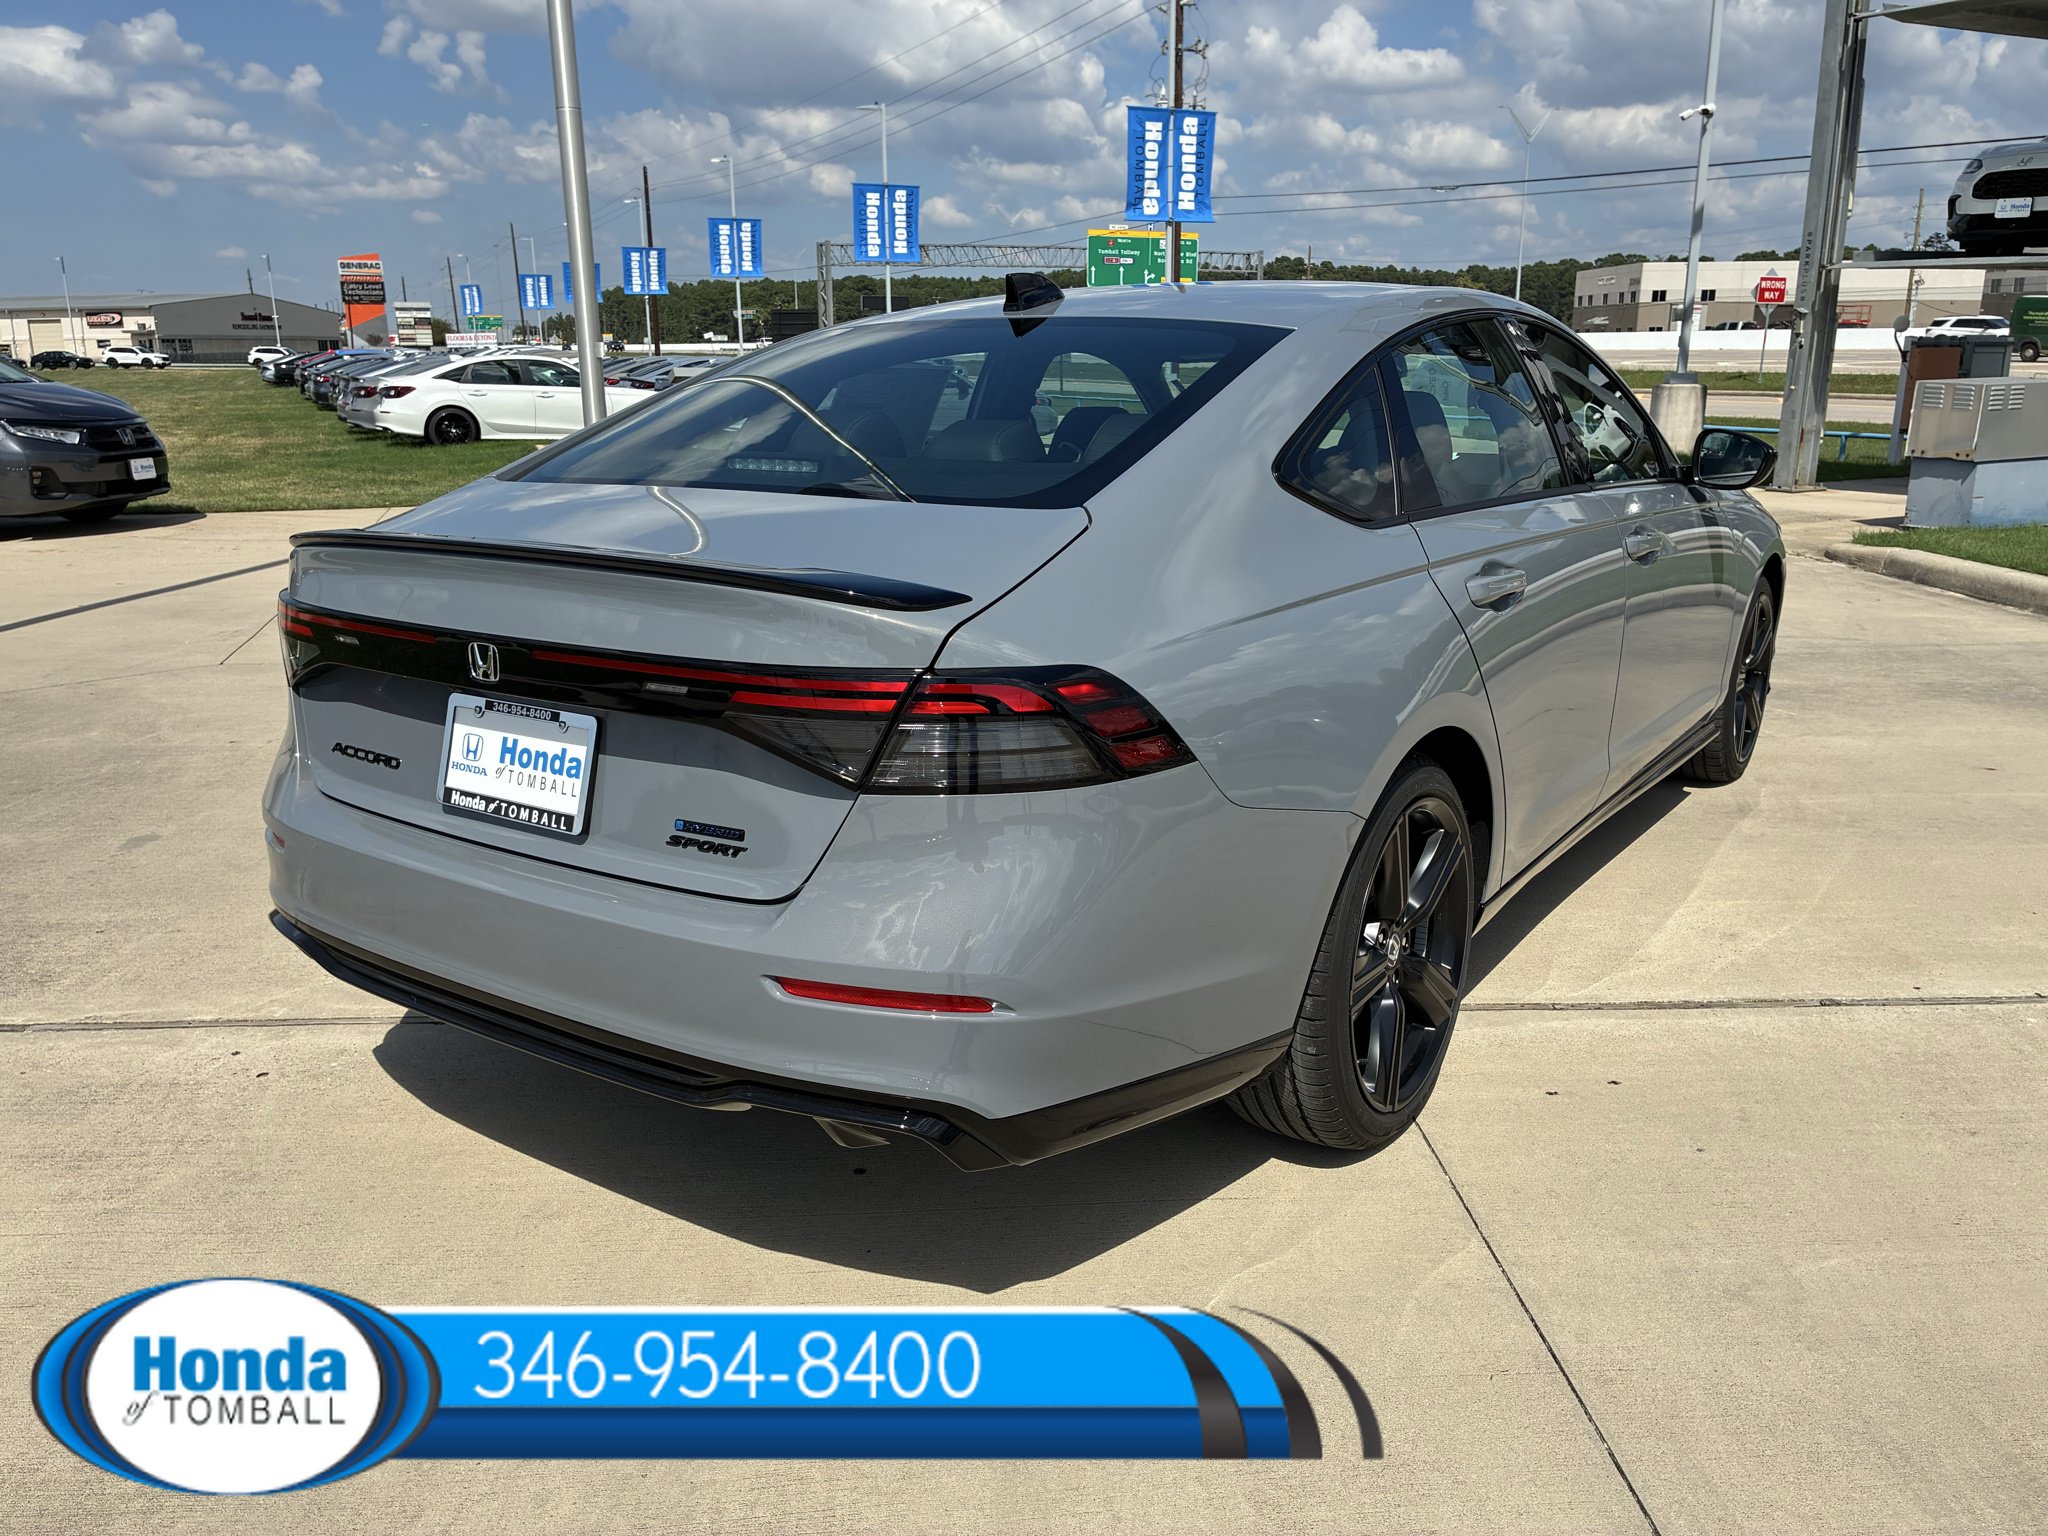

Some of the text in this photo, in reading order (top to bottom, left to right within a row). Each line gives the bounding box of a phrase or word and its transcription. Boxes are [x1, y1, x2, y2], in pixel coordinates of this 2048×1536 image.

[1133, 136, 1144, 214] TOMBALL
[1143, 121, 1163, 215] Honda
[1178, 117, 1198, 210] Honda
[1196, 119, 1208, 198] TOMBALL
[866, 192, 881, 257] Honda
[893, 189, 908, 254] Honda
[718, 224, 732, 274] Honda
[740, 222, 753, 271] Honda
[630, 252, 642, 292] Honda
[648, 250, 660, 290] Honda
[1760, 280, 1785, 289] WRONG
[525, 278, 535, 307] Honda
[539, 276, 548, 306] Honda
[1764, 291, 1780, 299] WAY
[493, 702, 551, 720] 346-954-8400
[331, 742, 401, 770] ACCORD
[451, 761, 488, 777] HONDA
[499, 736, 582, 779] Honda
[495, 764, 577, 797] of TOMBALL
[451, 790, 567, 830] Honda of TOMBALL
[684, 822, 741, 838] HYBRID
[666, 834, 748, 858] SPORT
